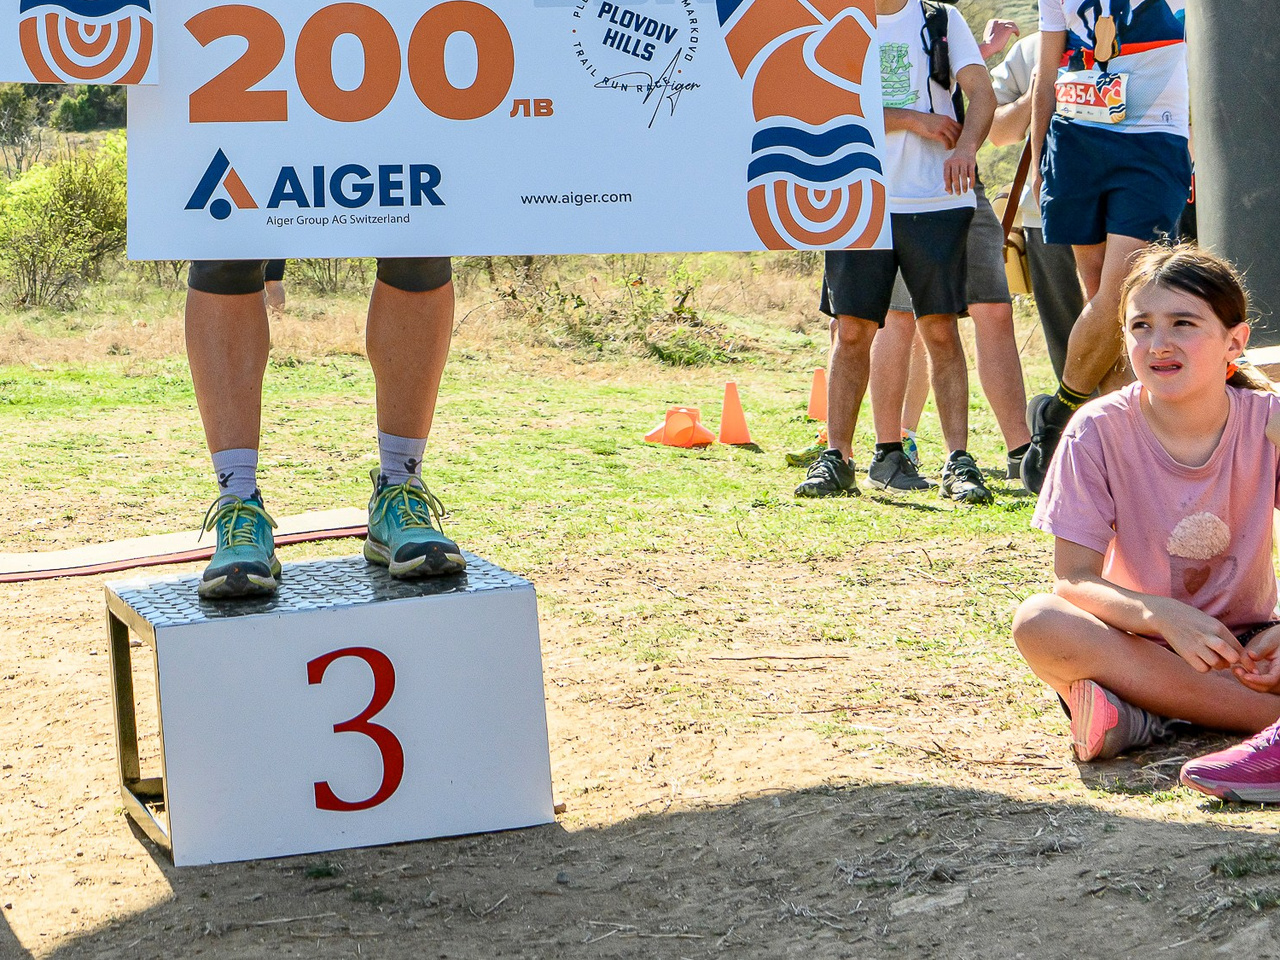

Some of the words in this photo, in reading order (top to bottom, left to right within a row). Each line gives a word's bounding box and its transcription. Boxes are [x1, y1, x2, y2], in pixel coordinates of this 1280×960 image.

[597, 1, 678, 44] PLOVDIV
[183, 0, 516, 124] 200
[510, 98, 554, 118] лв
[602, 28, 656, 62] HILLS
[574, 42, 597, 77] TRAIL
[603, 76, 628, 92] RUN
[1057, 84, 1095, 105] 2354
[266, 164, 446, 209] AIGER
[520, 191, 632, 206] www.aiger.com
[266, 216, 293, 227] Aiger
[297, 216, 329, 227] Group
[332, 215, 347, 224] AG
[350, 213, 410, 224] Switzerland
[306, 646, 405, 812] 3
